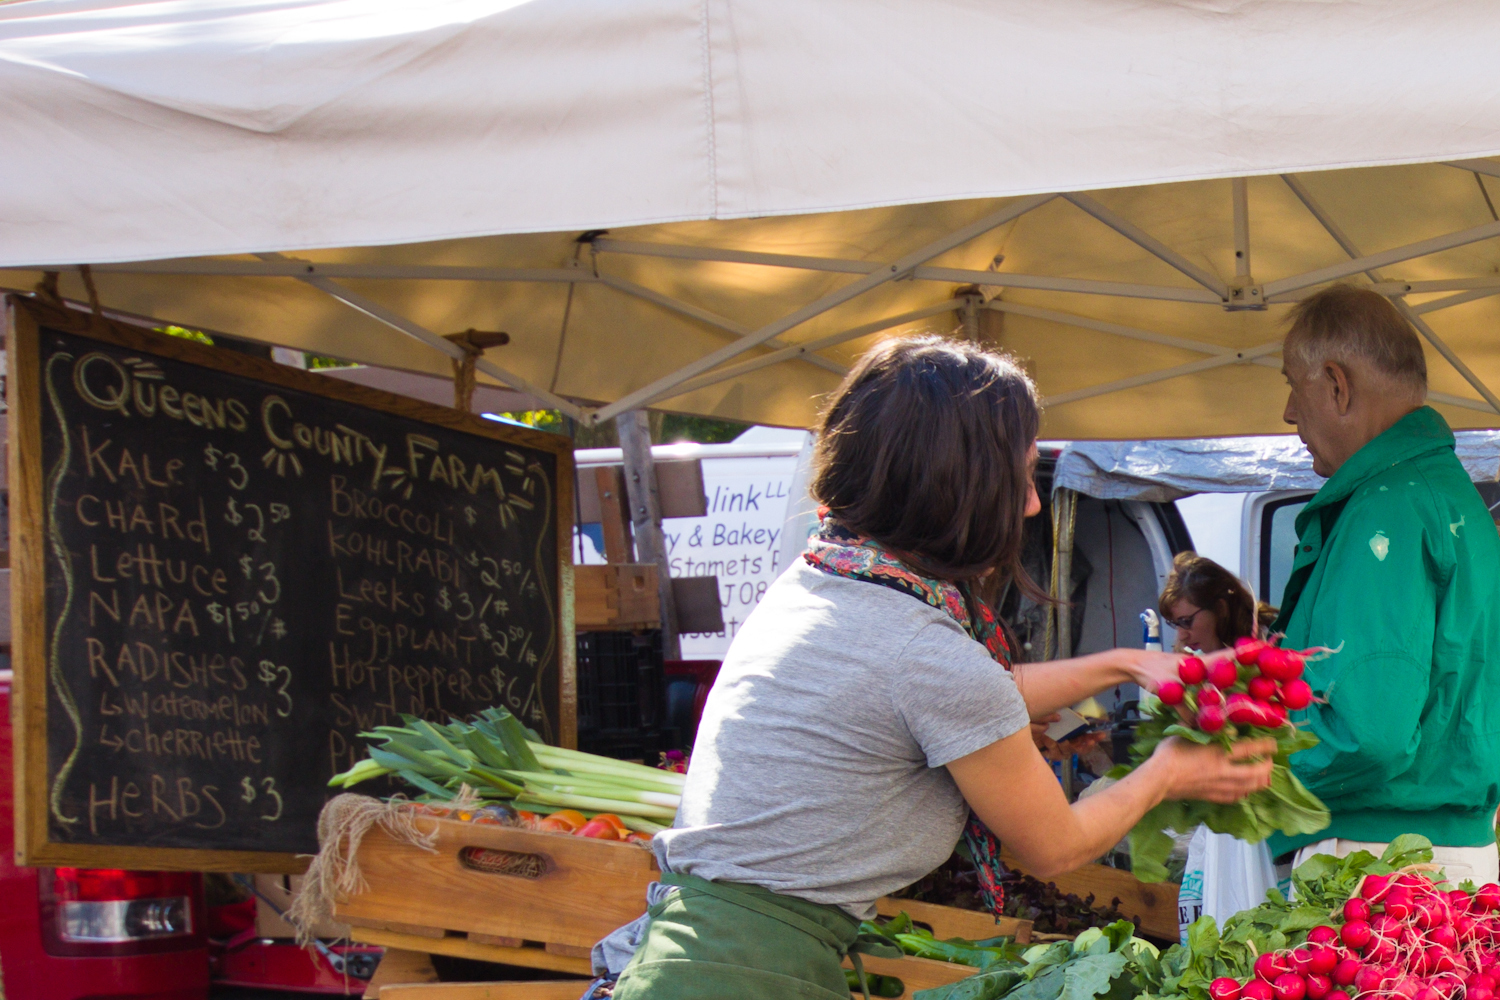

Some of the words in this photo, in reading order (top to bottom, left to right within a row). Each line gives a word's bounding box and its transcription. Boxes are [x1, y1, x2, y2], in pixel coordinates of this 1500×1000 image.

[204, 442, 249, 490] $3
[406, 433, 505, 498] FARM
[705, 484, 761, 513] link
[766, 481, 790, 498] LL
[664, 533, 681, 555] y
[689, 524, 702, 547] &
[239, 554, 281, 604] $3
[670, 554, 762, 578] Stamets
[90, 589, 199, 636] NAPA
[258, 660, 293, 717] $3
[241, 776, 284, 821] $3
